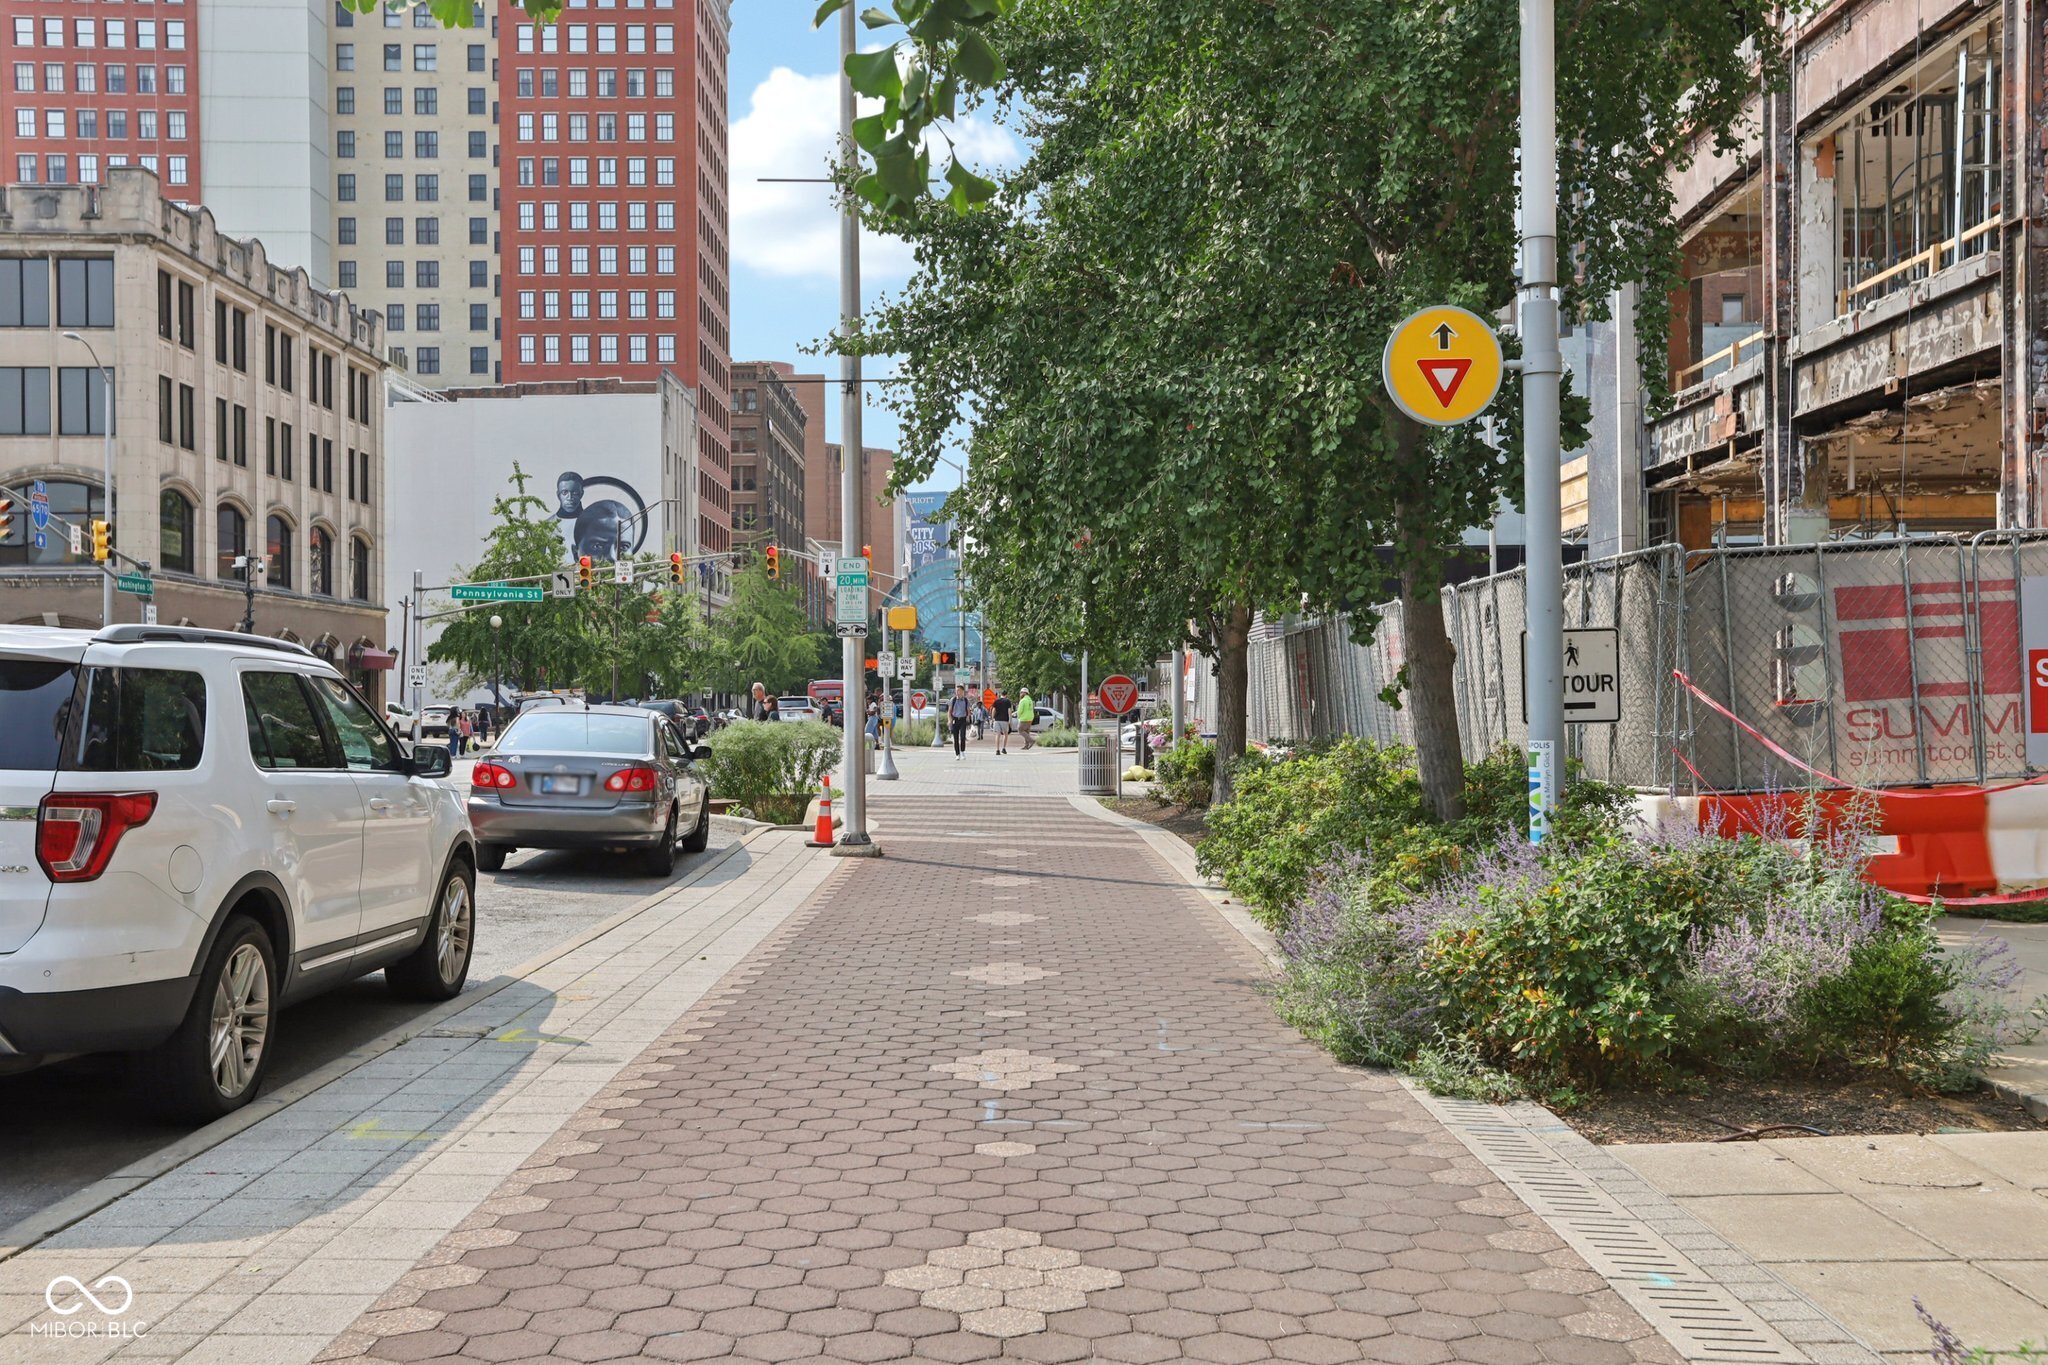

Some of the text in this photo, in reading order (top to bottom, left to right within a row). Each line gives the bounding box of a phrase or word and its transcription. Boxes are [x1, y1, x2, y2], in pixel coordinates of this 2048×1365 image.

[32, 503, 48, 516] 65 70
[911, 527, 934, 540] CITY
[911, 540, 937, 555] BOSS
[118, 580, 146, 592] Washington
[840, 575, 851, 585] 20
[455, 589, 538, 599] Pennsylvania St
[1563, 673, 1614, 694] TOUR
[1846, 701, 2025, 743] SUMMI
[1543, 751, 1551, 768] Glick
[1544, 768, 1552, 793] Marilyn
